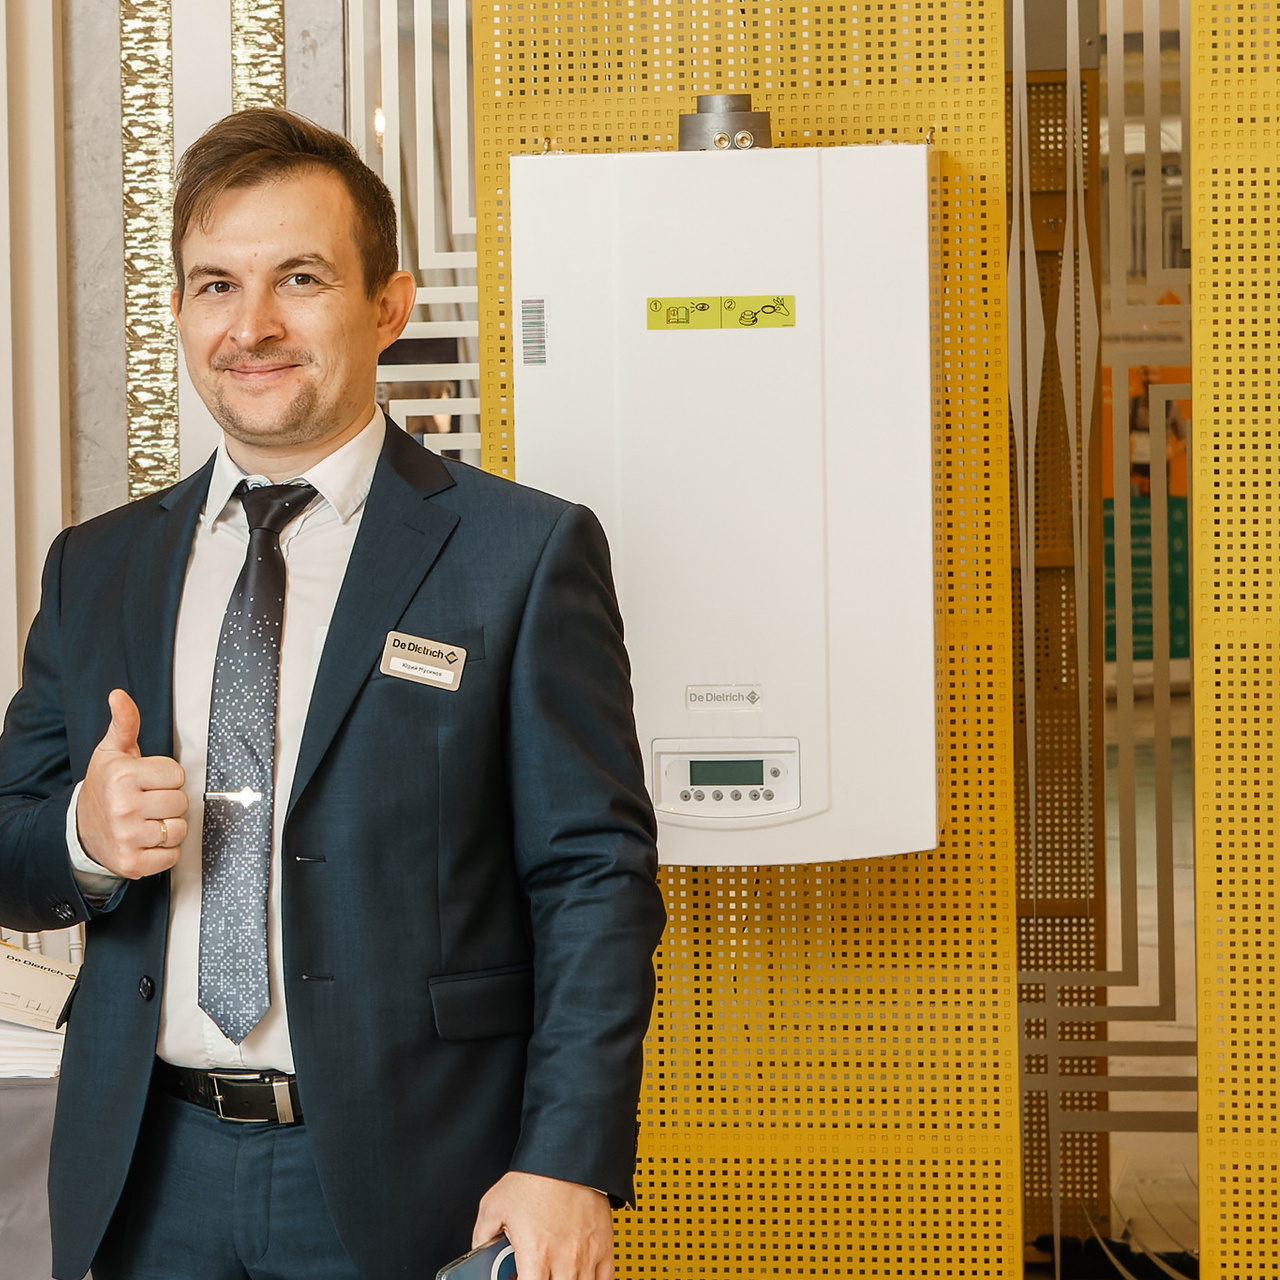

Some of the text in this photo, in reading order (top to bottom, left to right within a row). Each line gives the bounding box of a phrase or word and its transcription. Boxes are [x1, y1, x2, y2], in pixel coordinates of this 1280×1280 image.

[392, 638, 444, 659] De Dietrich
[689, 692, 745, 702] De Dietrich
[6, 954, 64, 976] De Dietrich
